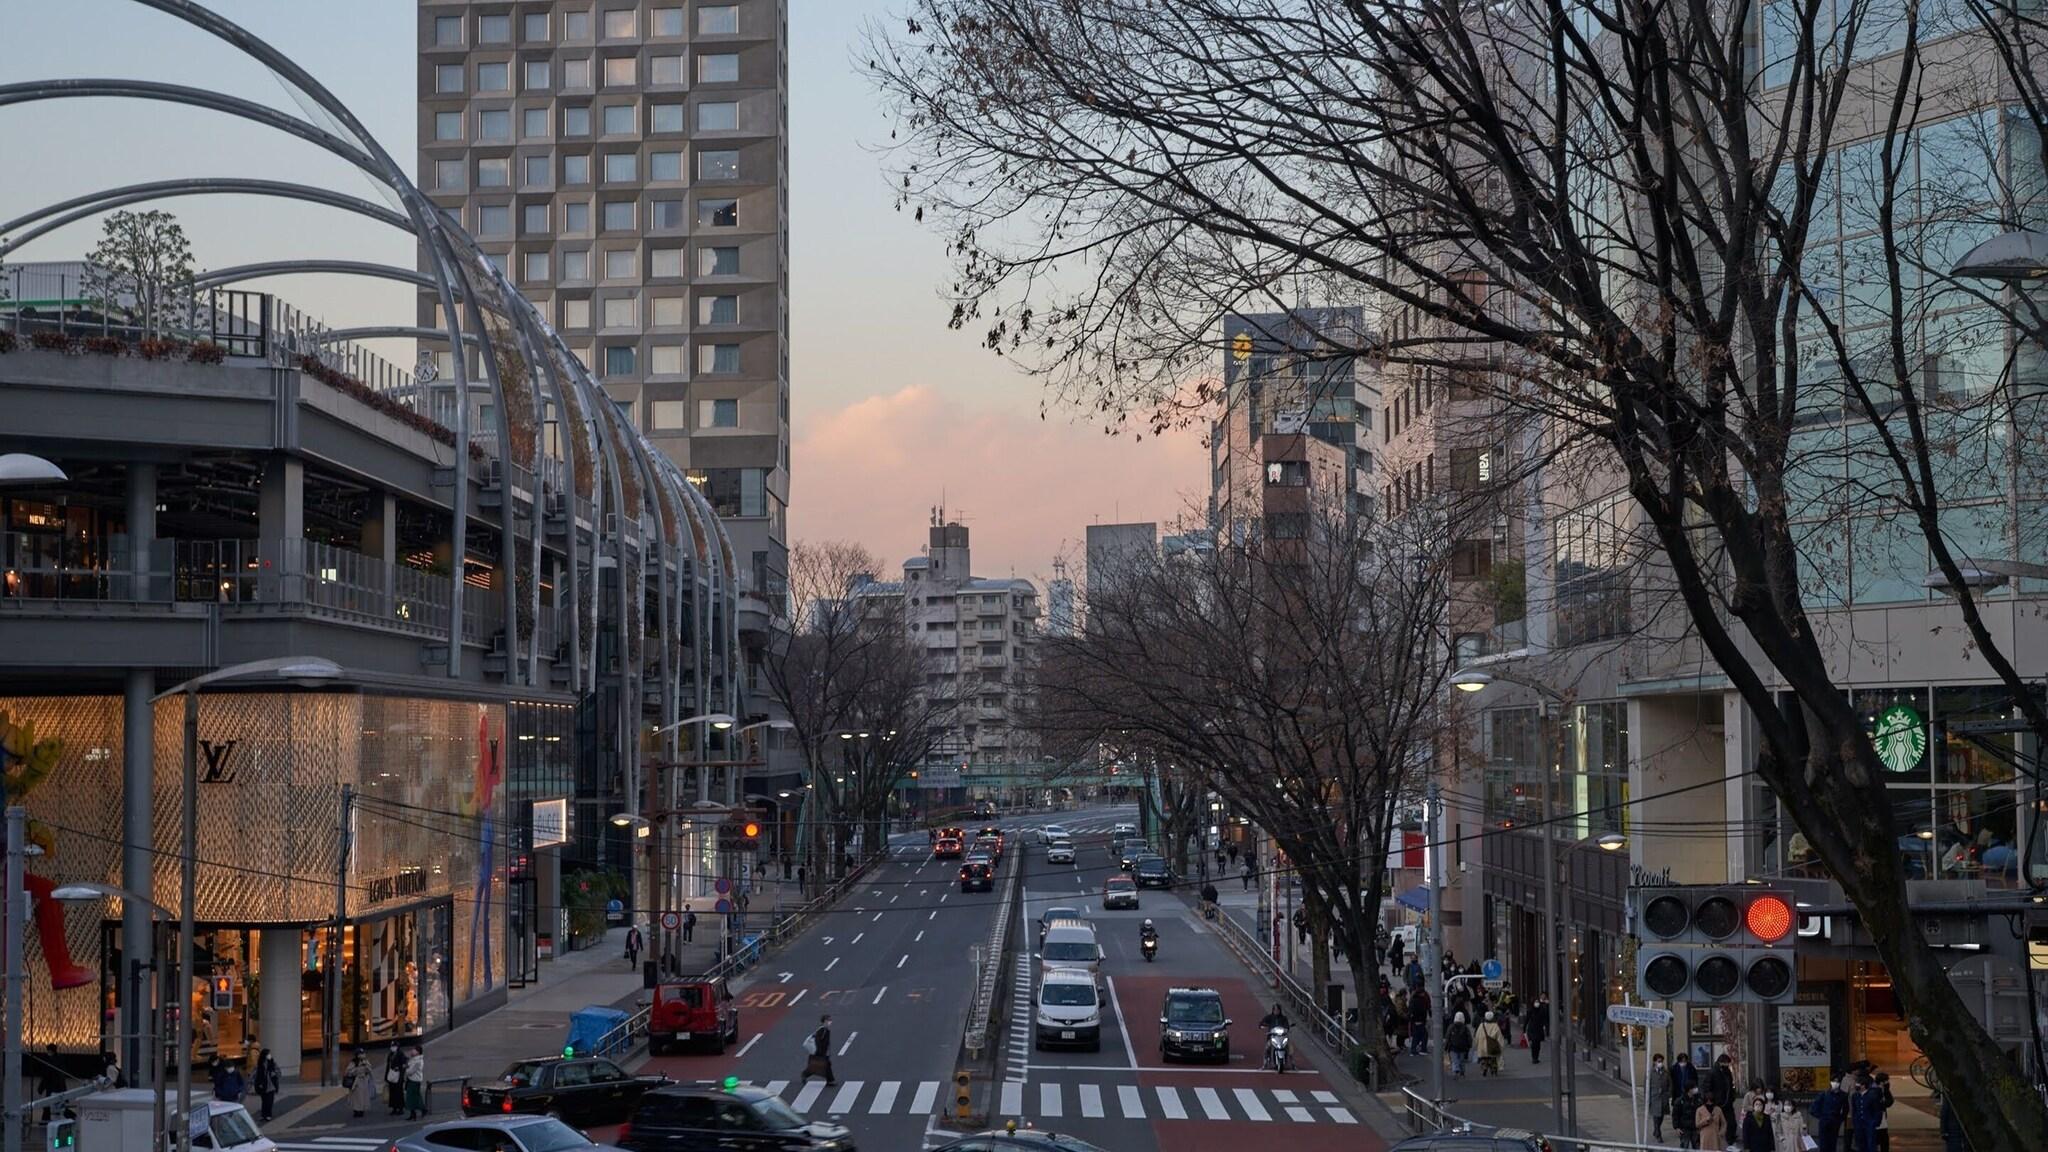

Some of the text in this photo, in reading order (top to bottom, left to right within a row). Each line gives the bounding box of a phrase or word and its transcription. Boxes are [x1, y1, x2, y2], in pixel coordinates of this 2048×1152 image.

[29, 513, 46, 525] NEW
[369, 868, 427, 903] LOUIS VUITTON
